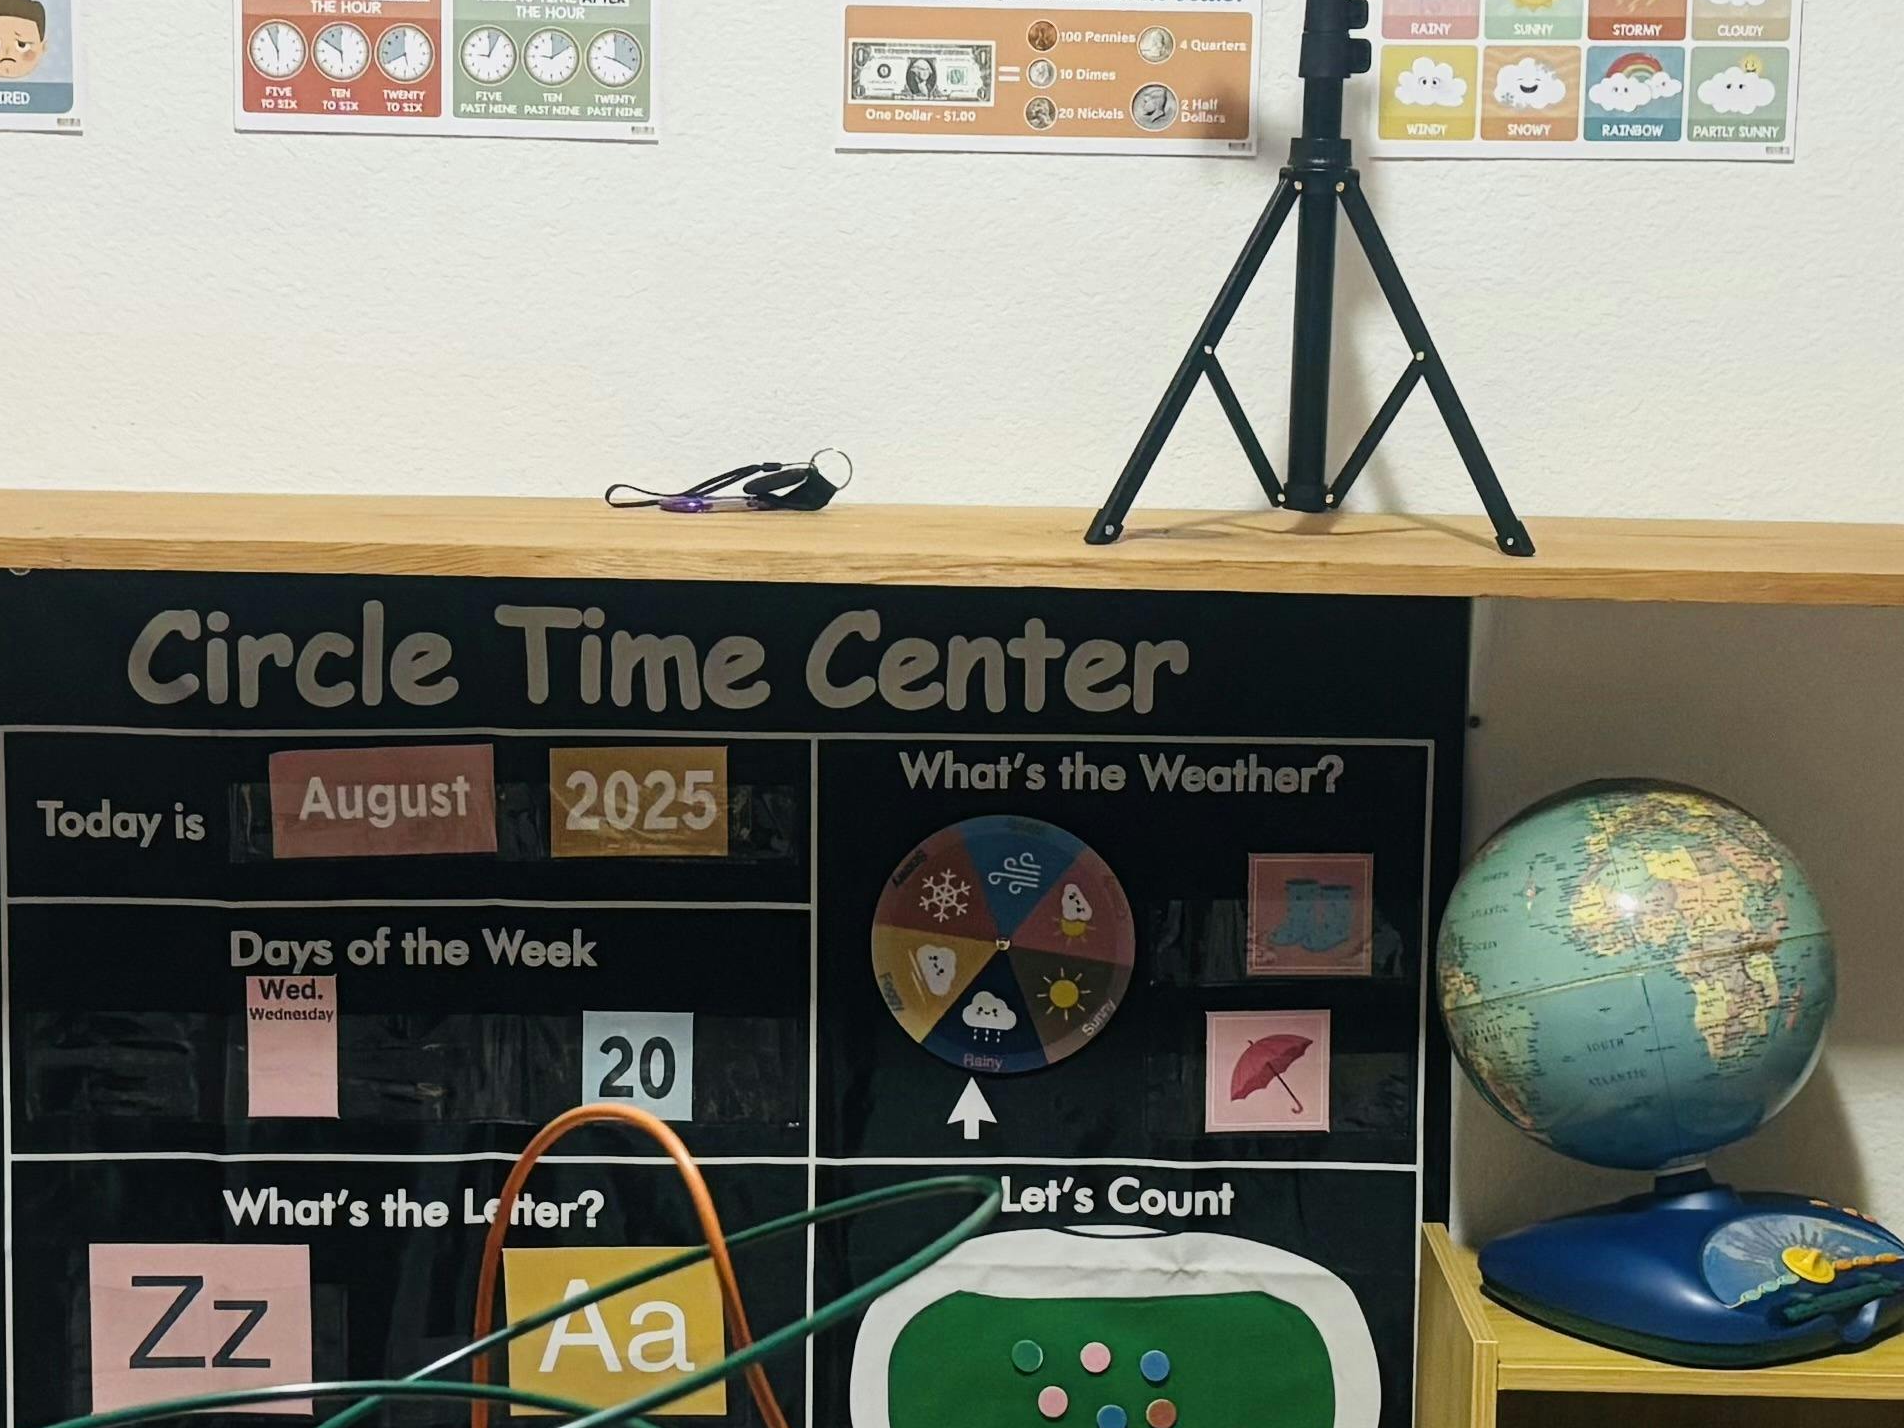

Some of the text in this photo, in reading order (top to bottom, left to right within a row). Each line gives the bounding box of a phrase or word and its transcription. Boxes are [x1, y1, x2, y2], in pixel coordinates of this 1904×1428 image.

[127, 600, 1189, 714] Circle Time Center
[899, 751, 1345, 794] What's the Weather?
[36, 770, 717, 847] Today is August 2025
[230, 928, 597, 973] Days of the Week
[259, 979, 324, 1002] Wed.
[248, 1008, 334, 1024] Wednesday
[598, 1036, 676, 1100] 20
[222, 1189, 370, 1226] What's
[381, 1191, 448, 1226] the
[999, 1176, 1235, 1217] Let's Count
[128, 1275, 271, 1370] Zz
[538, 1278, 696, 1373] Aa
